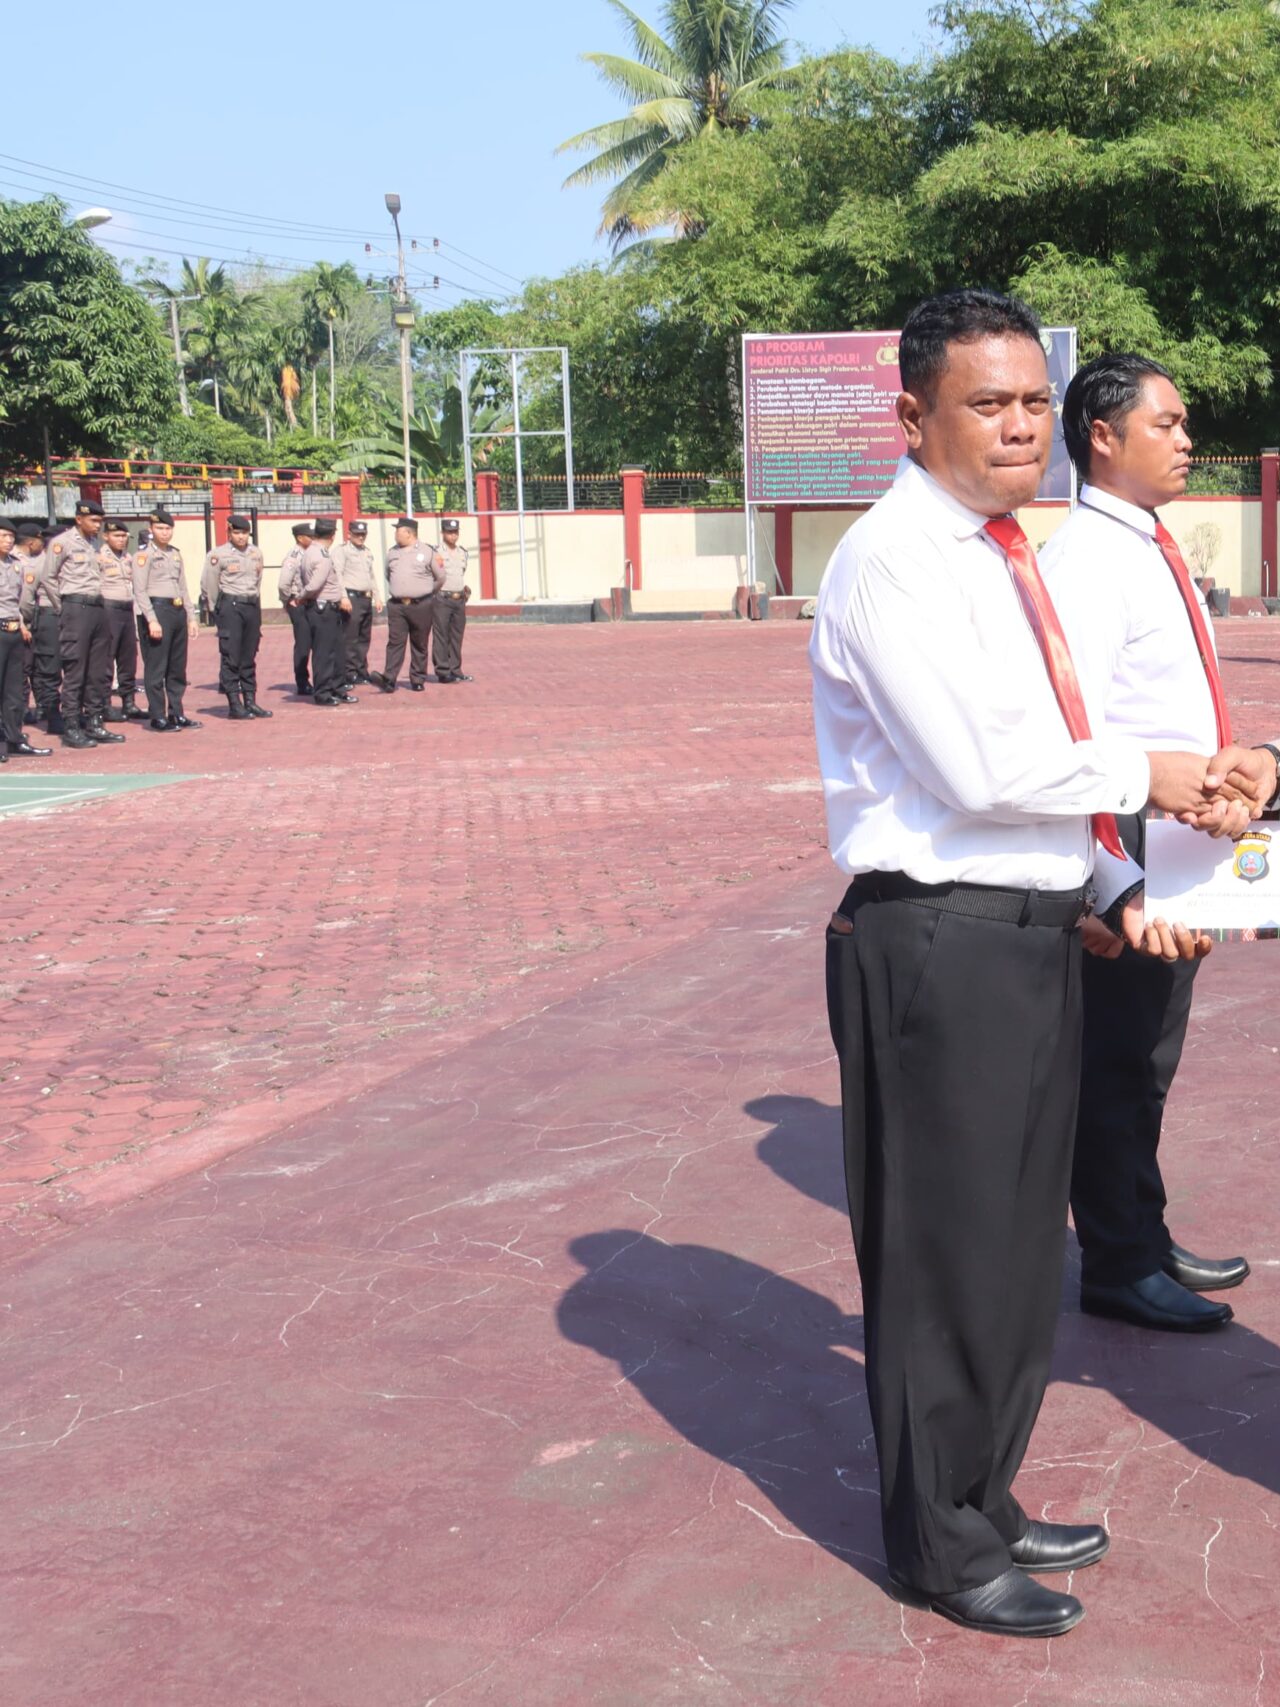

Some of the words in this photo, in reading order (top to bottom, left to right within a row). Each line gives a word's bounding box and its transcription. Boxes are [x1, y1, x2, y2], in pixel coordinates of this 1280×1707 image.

[751, 342, 763, 354] 16
[766, 341, 825, 353] PROGRAM
[750, 354, 808, 367] PRIORITAS
[810, 352, 860, 365] KAPOLRI
